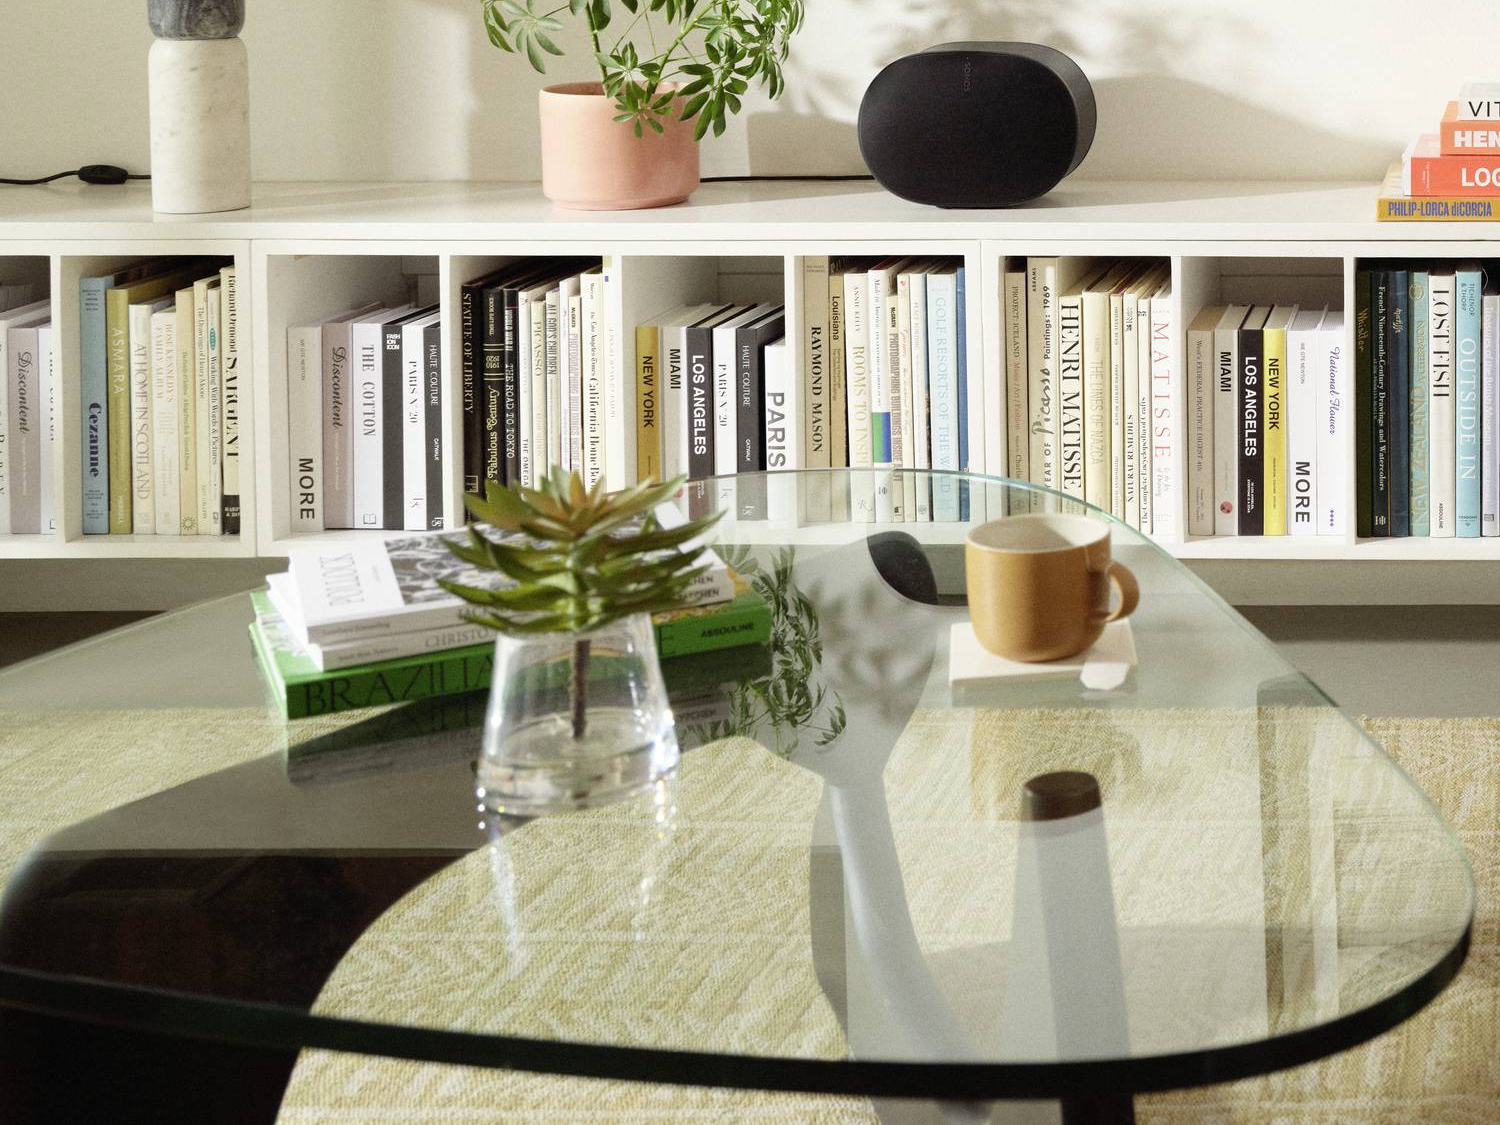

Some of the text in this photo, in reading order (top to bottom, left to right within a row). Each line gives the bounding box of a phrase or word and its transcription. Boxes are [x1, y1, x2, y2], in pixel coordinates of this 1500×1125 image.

[1387, 201, 1493, 217] PHILIP-LORCA diCORCIA
[504, 309, 513, 331] WORLD
[831, 296, 841, 341] Louisiana
[1011, 285, 1021, 358] PROJECT ICELAND
[1043, 285, 1051, 310] 1969
[112, 327, 126, 395] ASMARA
[463, 292, 474, 414] STATUE OF LIBERTY
[505, 331, 513, 345] WAR
[533, 321, 542, 377] PICASSO
[669, 348, 681, 390] MIAMI
[1043, 314, 1052, 360] Paintings:
[1089, 360, 1104, 378] THE
[1432, 289, 1450, 398] LOST FISH
[209, 356, 217, 386] Working
[210, 387, 218, 403] With
[331, 346, 348, 429] Discontent
[362, 344, 376, 436] THE COTTON
[408, 360, 418, 395] PARIS
[429, 345, 439, 406] HAUTE COUTURE
[570, 332, 581, 462] PHOTOGRAPHING BUILDINGS INSIDE
[642, 355, 654, 428] NEW YORK
[718, 364, 728, 398] PARIS
[742, 345, 751, 407] HAUTE COUTURE
[811, 326, 823, 453] RAYMOND MASON
[889, 332, 902, 462] PHOTOGRAPHING BUILDINGS INSIDE
[935, 297, 952, 493] GOLF RESORTS OF THE WLD
[1061, 304, 1083, 490] HENRI MATISSE
[1153, 321, 1171, 458] MATISSE
[1195, 361, 1204, 395] FEDERAL
[1220, 351, 1232, 392] MIAMI
[1268, 357, 1280, 430] NEW YORK
[1328, 346, 1341, 436] National Flower
[1377, 285, 1387, 491] French Nineteenth-Century Drawings and Watercolors
[133, 342, 150, 499] AT HOME IN SCOTLAND
[211, 404, 219, 427] Words
[486, 385, 500, 479] Fabulous Century
[505, 363, 515, 459] THE ROAD TO TOKYO
[589, 377, 600, 466] California Home
[692, 354, 706, 455] LOS ANGELES
[718, 414, 728, 427] 20
[767, 392, 786, 468] PARIS
[852, 345, 869, 466] ROOMS TO INSPI
[1196, 396, 1204, 432] PRACTICE
[1244, 356, 1258, 456] LOS ANGELES
[1459, 337, 1477, 480] OUTSIDE IN
[88, 402, 103, 478] Cezanne
[1044, 442, 1052, 456] OF
[1196, 433, 1204, 460] DIGEST
[299, 458, 315, 520] MORE
[1295, 461, 1311, 523] MORE
[701, 623, 755, 638] ASSOULINE
[304, 651, 497, 716] BRAZILIA
